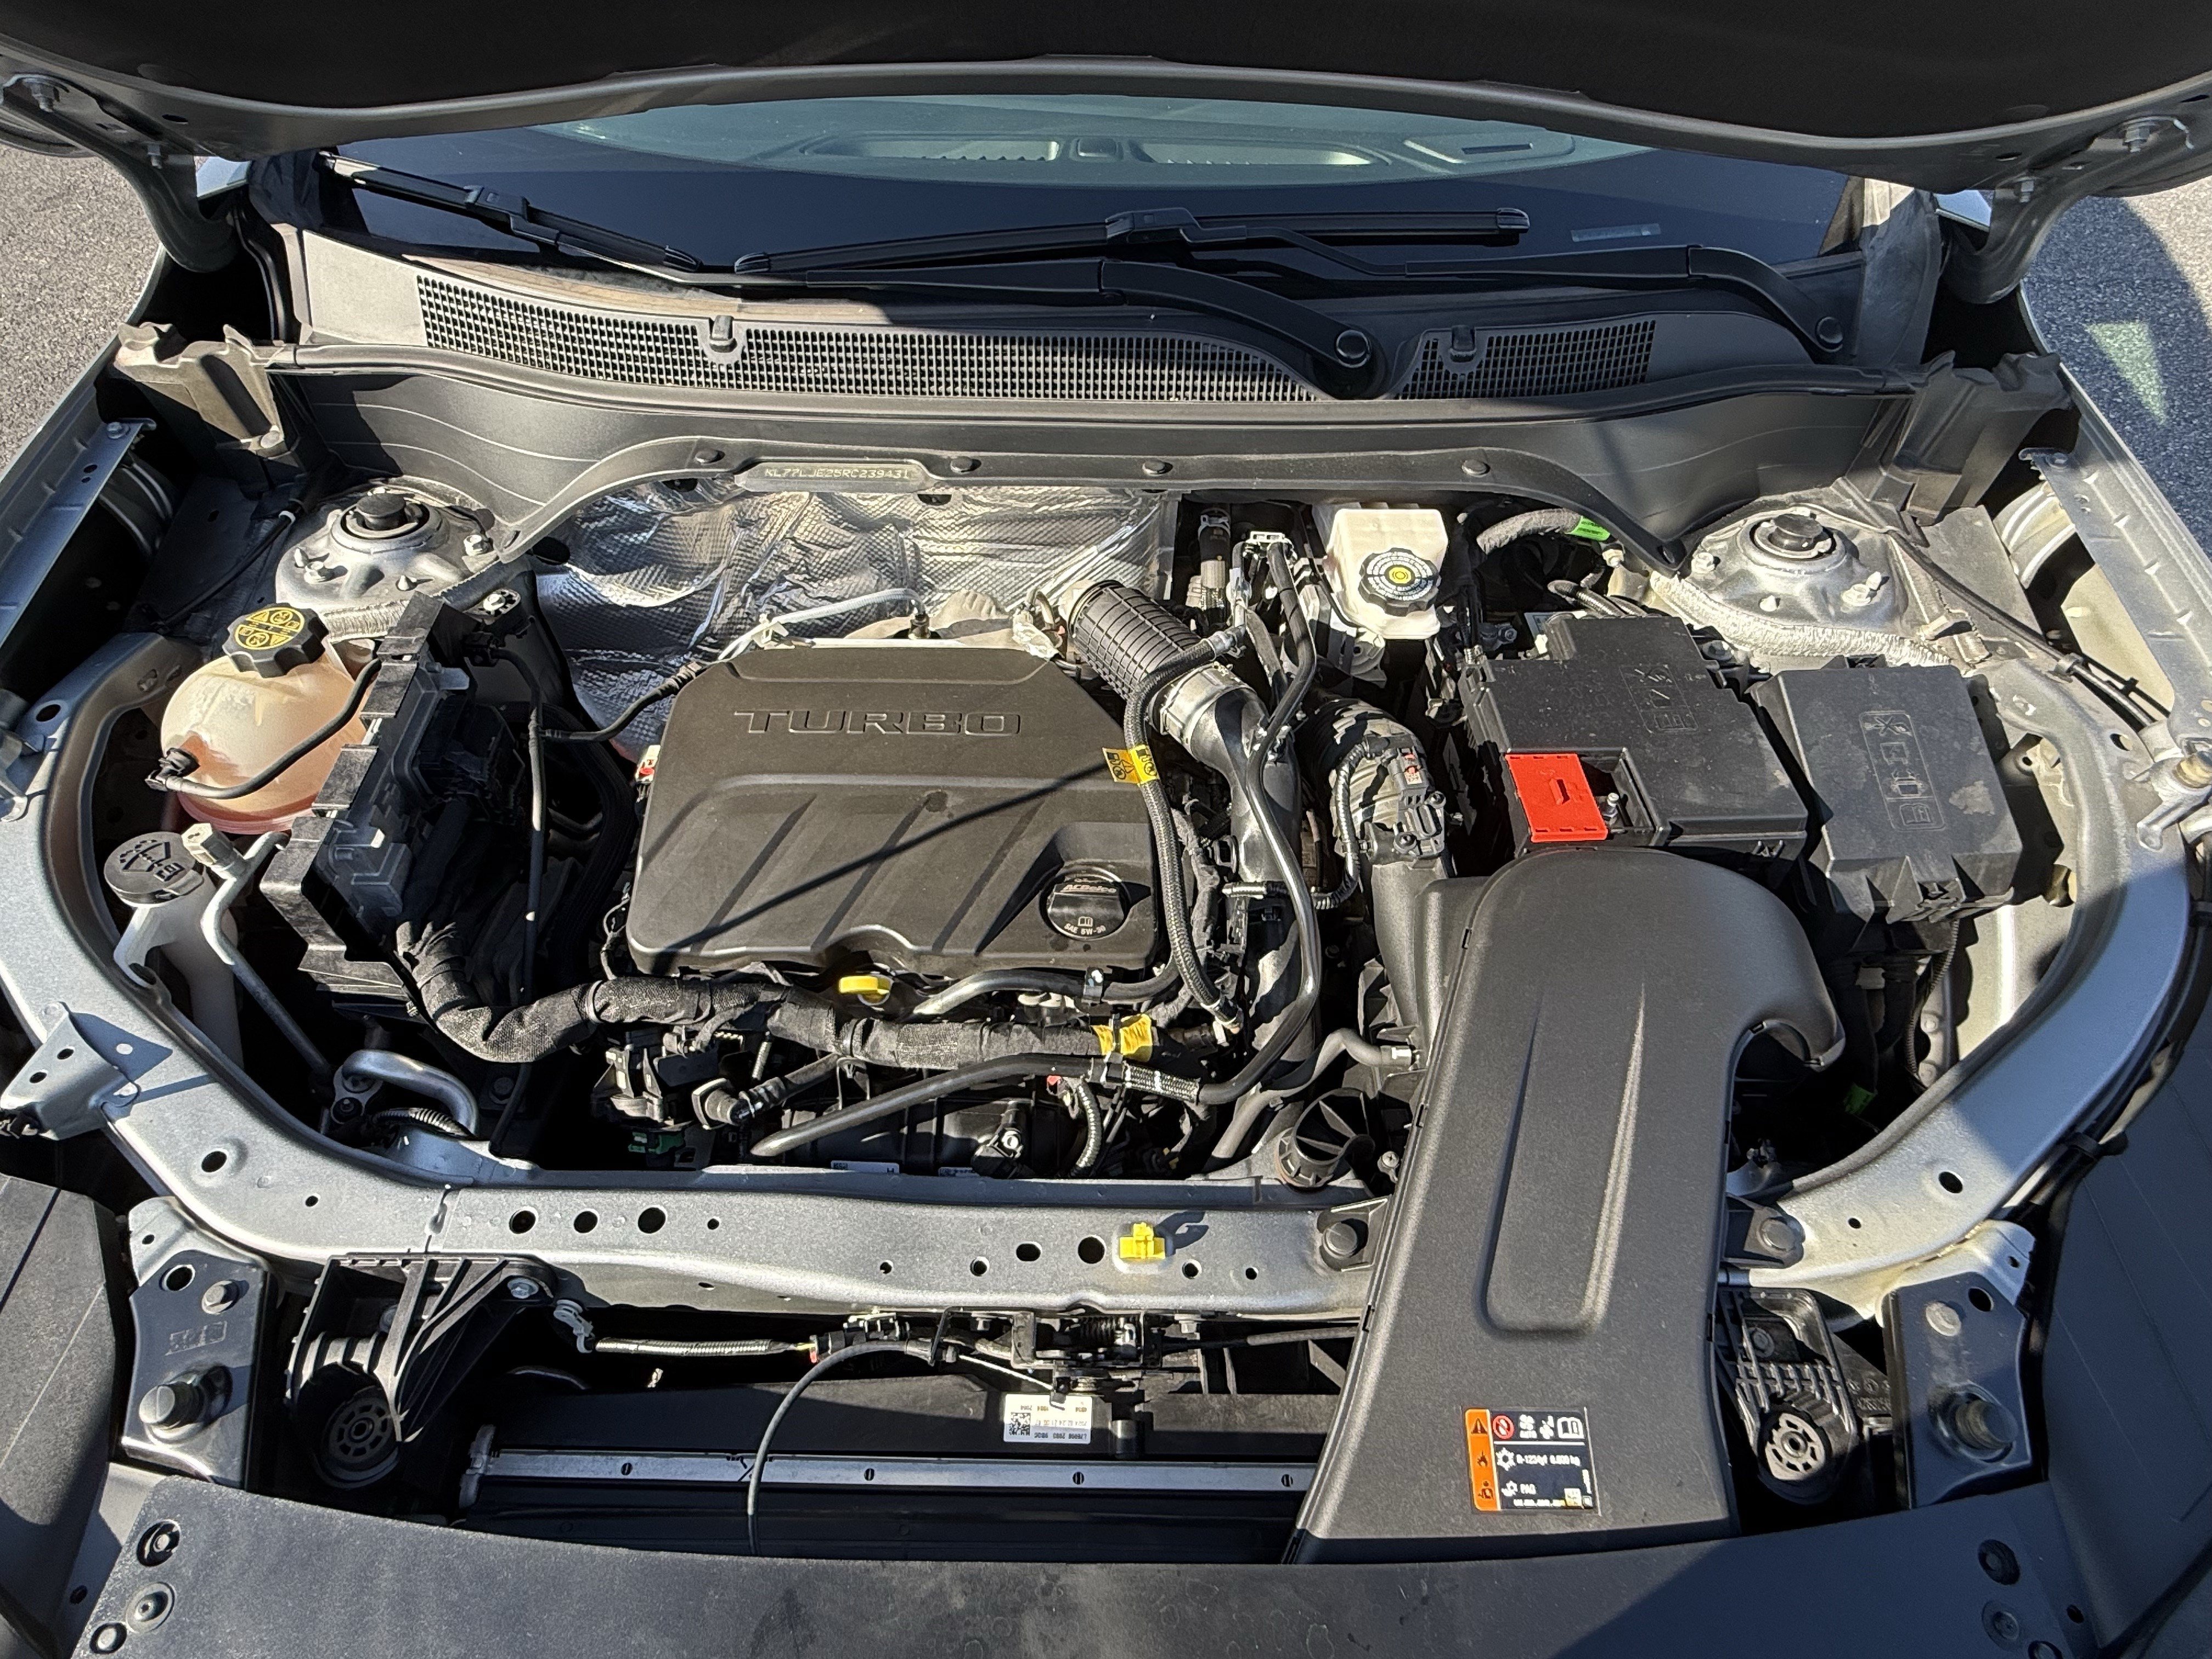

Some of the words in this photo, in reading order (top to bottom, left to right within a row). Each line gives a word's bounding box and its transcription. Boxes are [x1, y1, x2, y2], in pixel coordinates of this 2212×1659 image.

[765, 468, 910, 479] KL77LJE25RC239431
[733, 709, 1021, 735] TURBO
[1060, 884, 1117, 893] ACDelco
[1064, 923, 1079, 934] SAE
